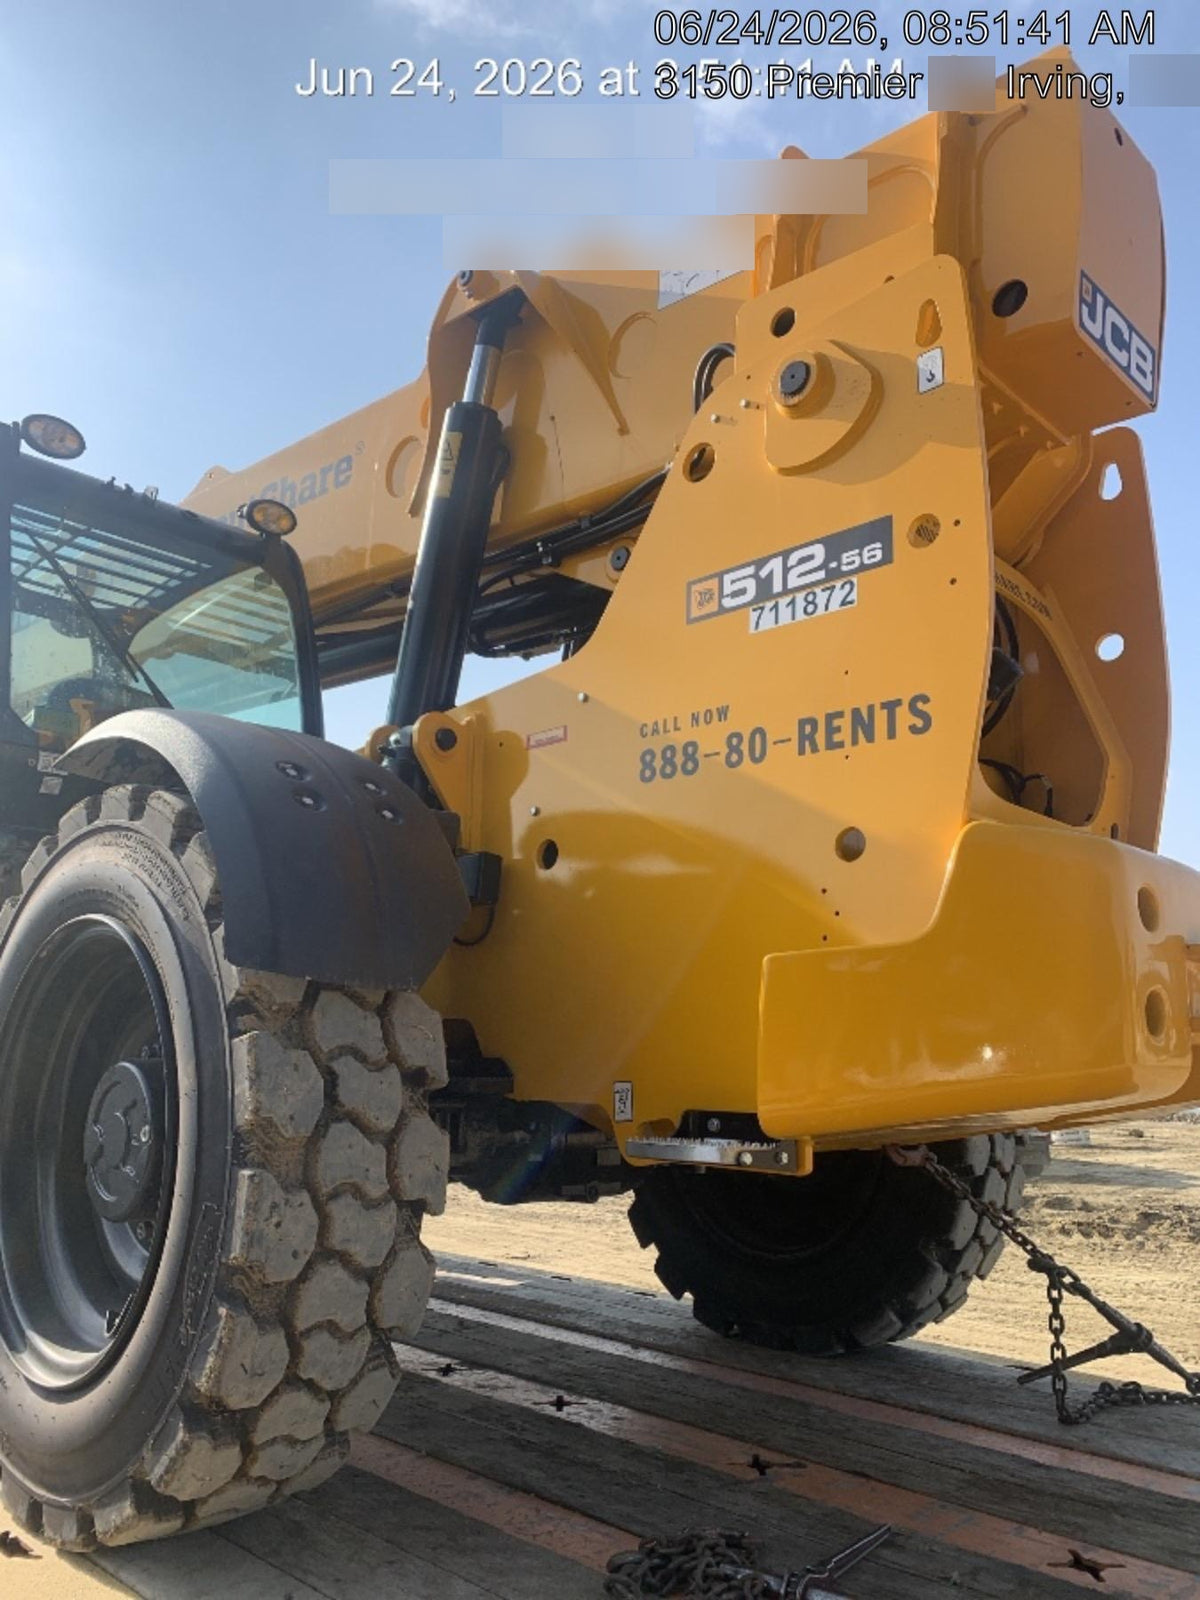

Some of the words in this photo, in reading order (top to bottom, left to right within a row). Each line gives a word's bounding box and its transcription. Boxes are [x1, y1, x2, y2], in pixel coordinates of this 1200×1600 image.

[1082, 291, 1153, 392] JCB
[751, 579, 855, 631] 711872
[639, 716, 681, 738] CALL
[690, 705, 730, 727] NOW
[639, 693, 932, 783] 888-80-RENTS
